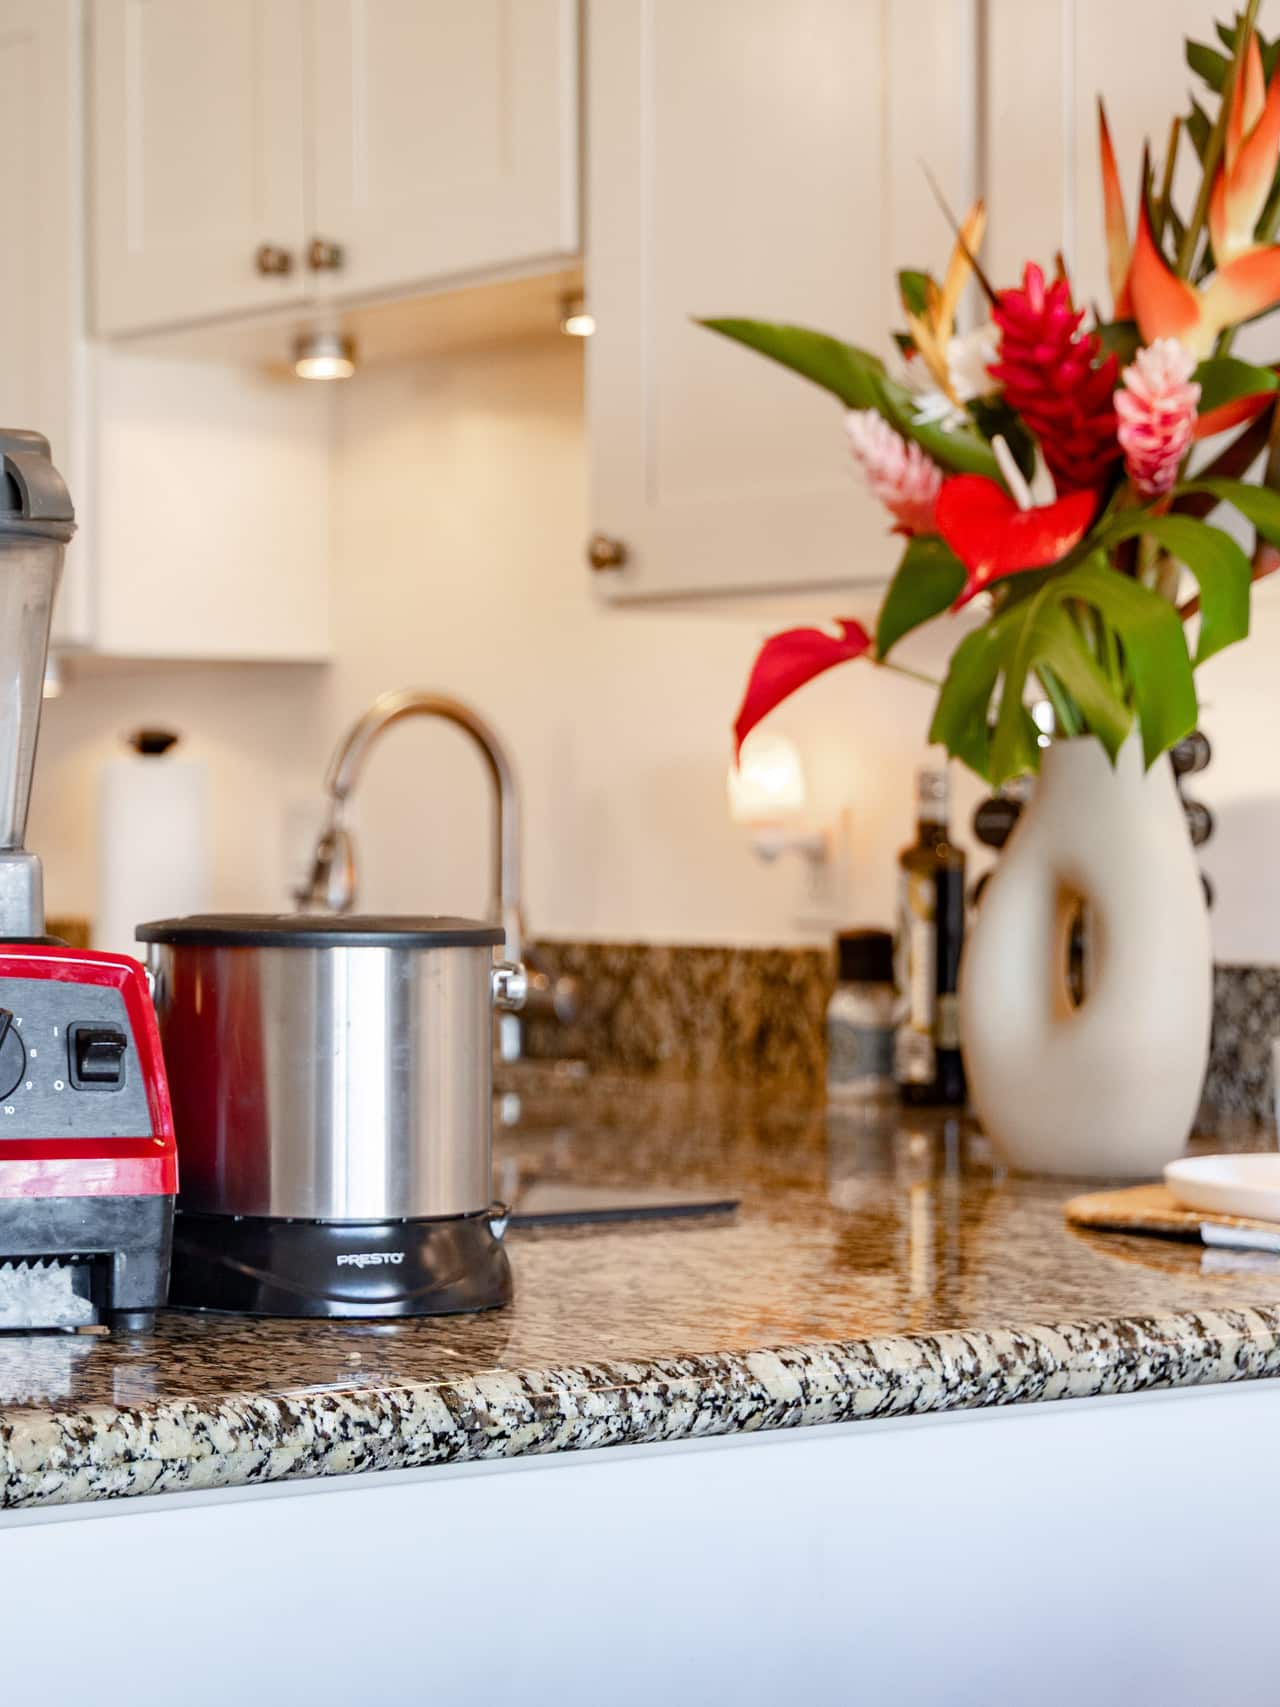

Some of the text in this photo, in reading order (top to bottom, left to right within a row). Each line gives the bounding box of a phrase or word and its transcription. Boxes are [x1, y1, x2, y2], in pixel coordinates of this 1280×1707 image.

[16, 1018, 23, 1026] 7
[30, 1049, 37, 1058] 8
[26, 1081, 33, 1090] 9
[4, 1106, 15, 1114] 10
[336, 1252, 404, 1268] PRESTO
